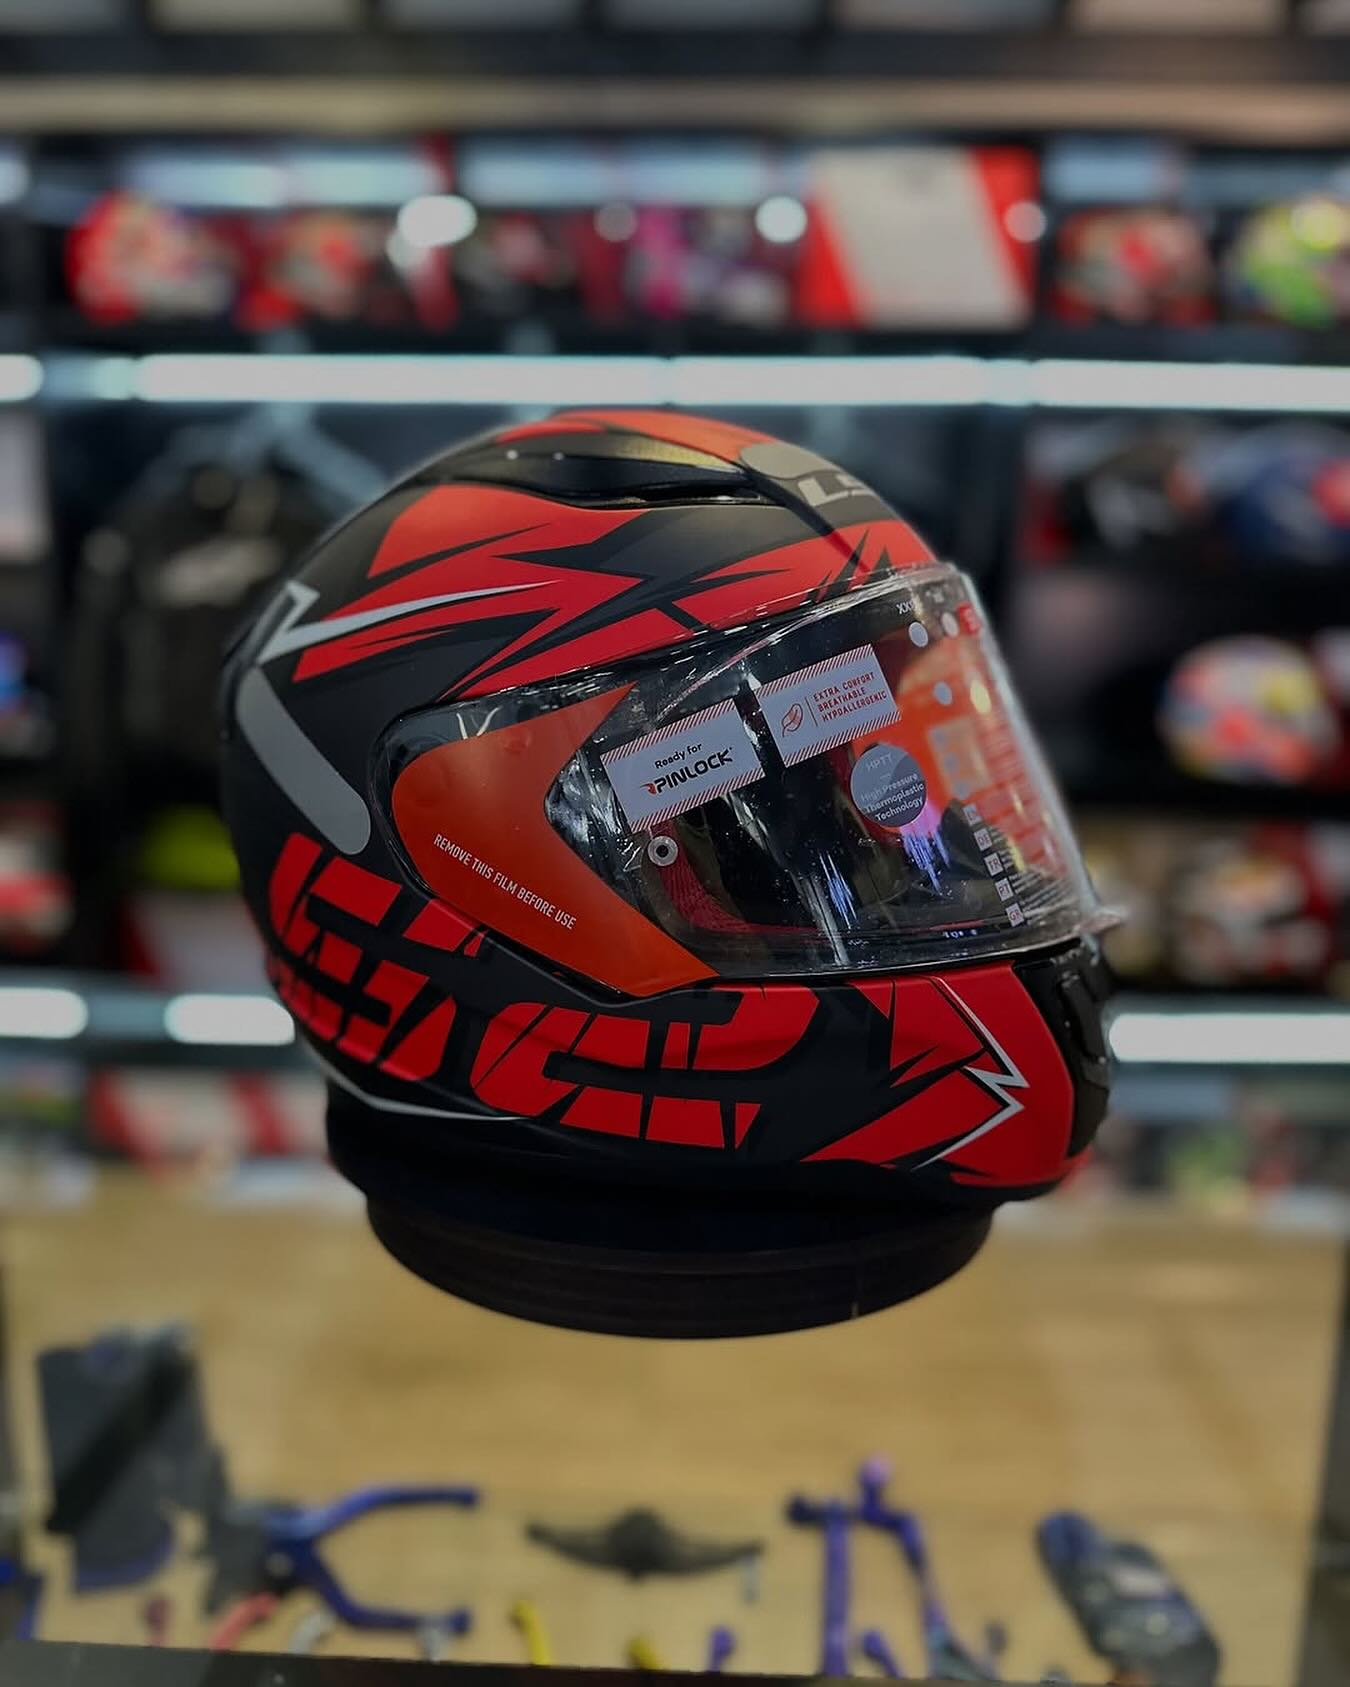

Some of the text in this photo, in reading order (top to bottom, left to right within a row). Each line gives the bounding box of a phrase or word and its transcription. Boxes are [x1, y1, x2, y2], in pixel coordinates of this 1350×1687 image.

[813, 686, 840, 702] EXTRA
[817, 687, 866, 712] BREATHABLE
[821, 690, 887, 722] HYPOALLERGENIC
[654, 743, 702, 769] Ready for
[866, 753, 893, 771] HPTT
[653, 749, 733, 794] PINLOCK
[860, 773, 918, 802] High Pressure
[863, 783, 925, 813] Thermoplastic
[875, 796, 924, 821] Technology
[433, 834, 577, 930] REMOVE THIS FILM BEFORE USE
